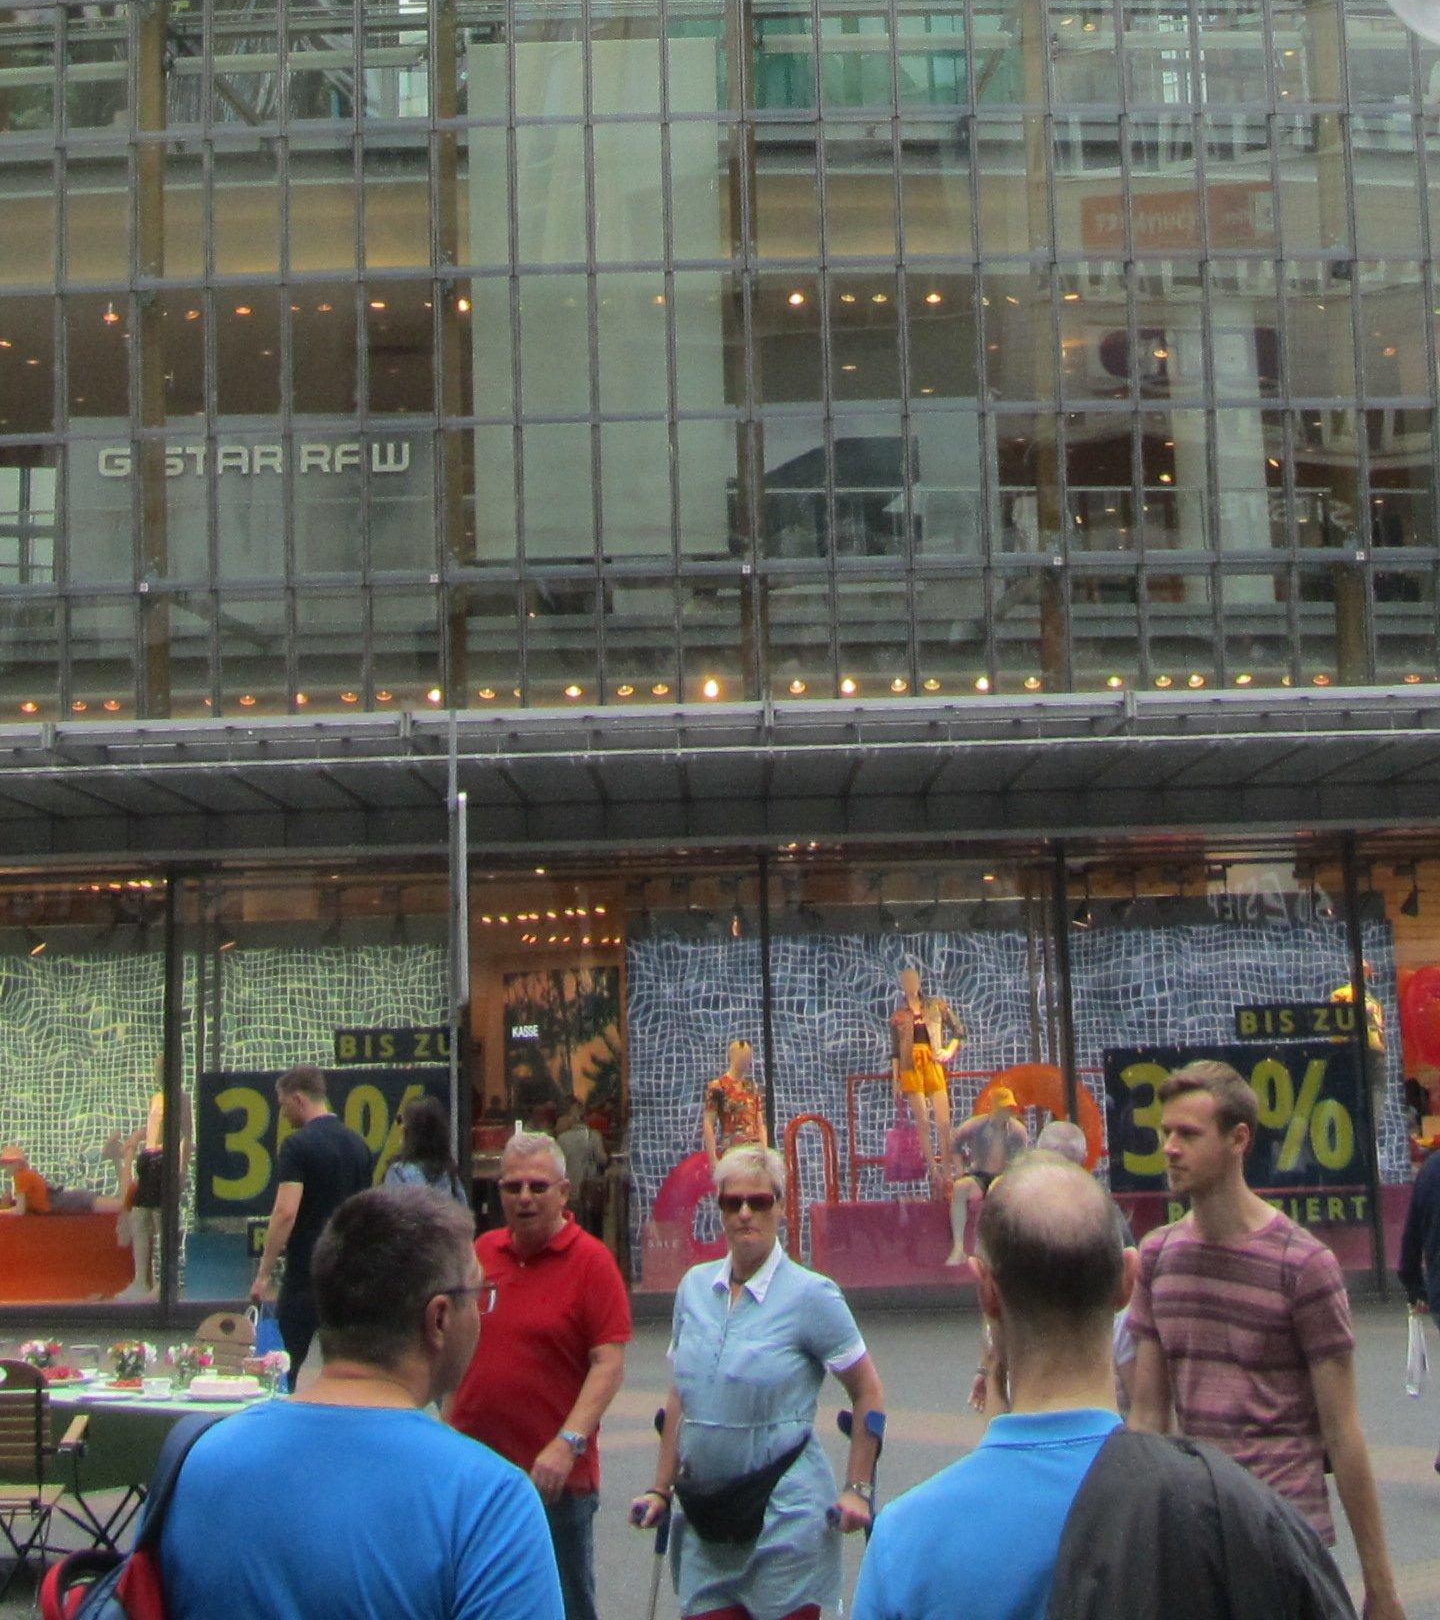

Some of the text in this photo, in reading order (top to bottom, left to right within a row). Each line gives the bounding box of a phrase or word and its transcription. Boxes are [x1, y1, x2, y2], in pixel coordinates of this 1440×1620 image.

[97, 446, 283, 477] GSTAR
[511, 1024, 540, 1038] KASSE
[1239, 1007, 1356, 1035] BIS ZU
[339, 1033, 395, 1058] BIS
[1120, 1057, 1354, 1176] 3%
[212, 1084, 426, 1201] 3%
[1168, 1195, 1368, 1224] RIERT
